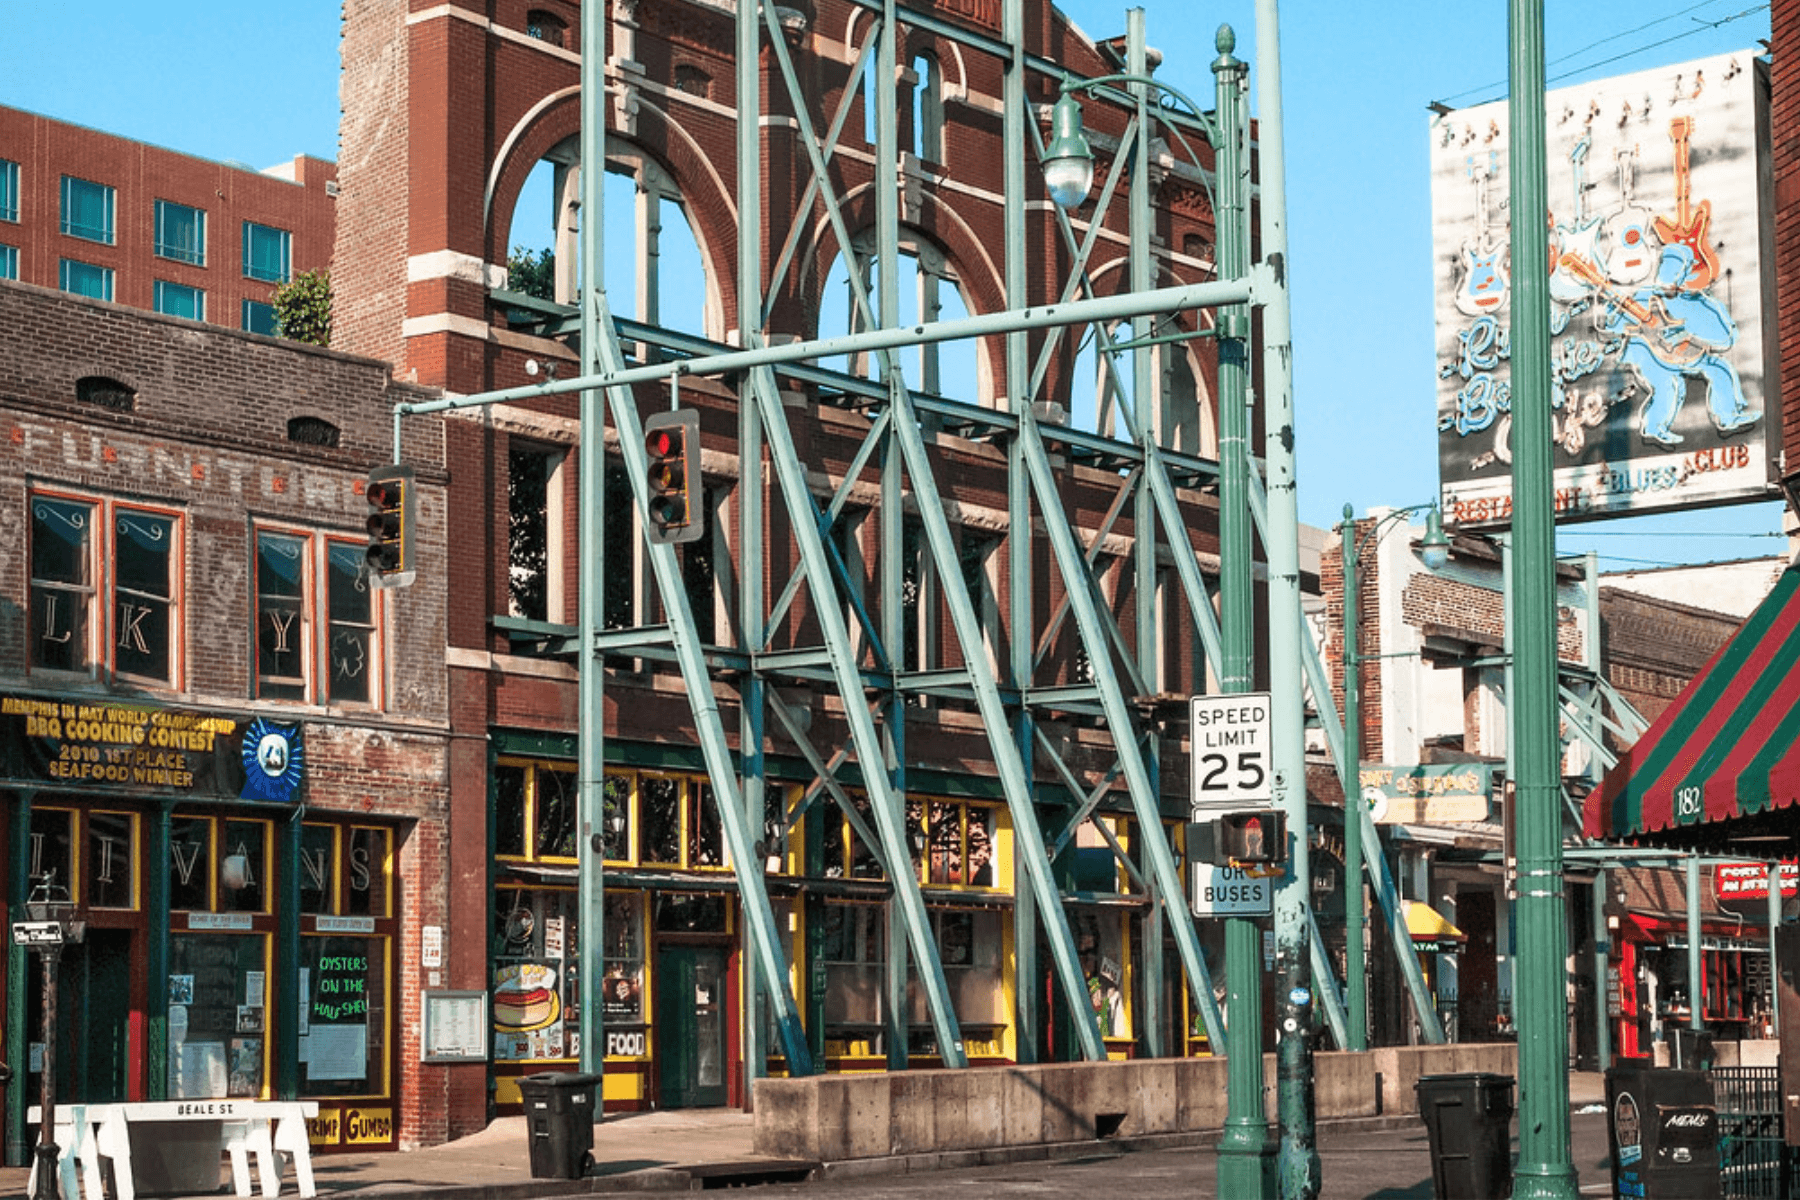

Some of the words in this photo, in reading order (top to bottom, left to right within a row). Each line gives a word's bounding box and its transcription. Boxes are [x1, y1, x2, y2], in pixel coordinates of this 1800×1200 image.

[1454, 487, 1582, 522] RESTANT
[1694, 445, 1750, 472] CLUB
[106, 709, 148, 726] WORLD
[1198, 706, 1265, 726] SPEED
[65, 719, 145, 745] COOKING
[149, 727, 215, 752] CONTEST
[1205, 729, 1257, 747] LIMIT
[60, 744, 100, 762] 2010
[104, 748, 132, 764] 1ST
[136, 751, 185, 770] PLACE
[50, 761, 129, 781] SEAFOOD
[133, 767, 193, 787] WINNER
[1200, 752, 1265, 791] 25
[1677, 786, 1700, 816] 182
[1204, 885, 1263, 902] BUSES
[320, 956, 368, 971] OYSTERS
[321, 978, 339, 993] ON
[344, 978, 365, 993] THE
[607, 1032, 645, 1055] FOOD
[177, 1104, 214, 1115] BEALE
[306, 1118, 338, 1138] RIMP
